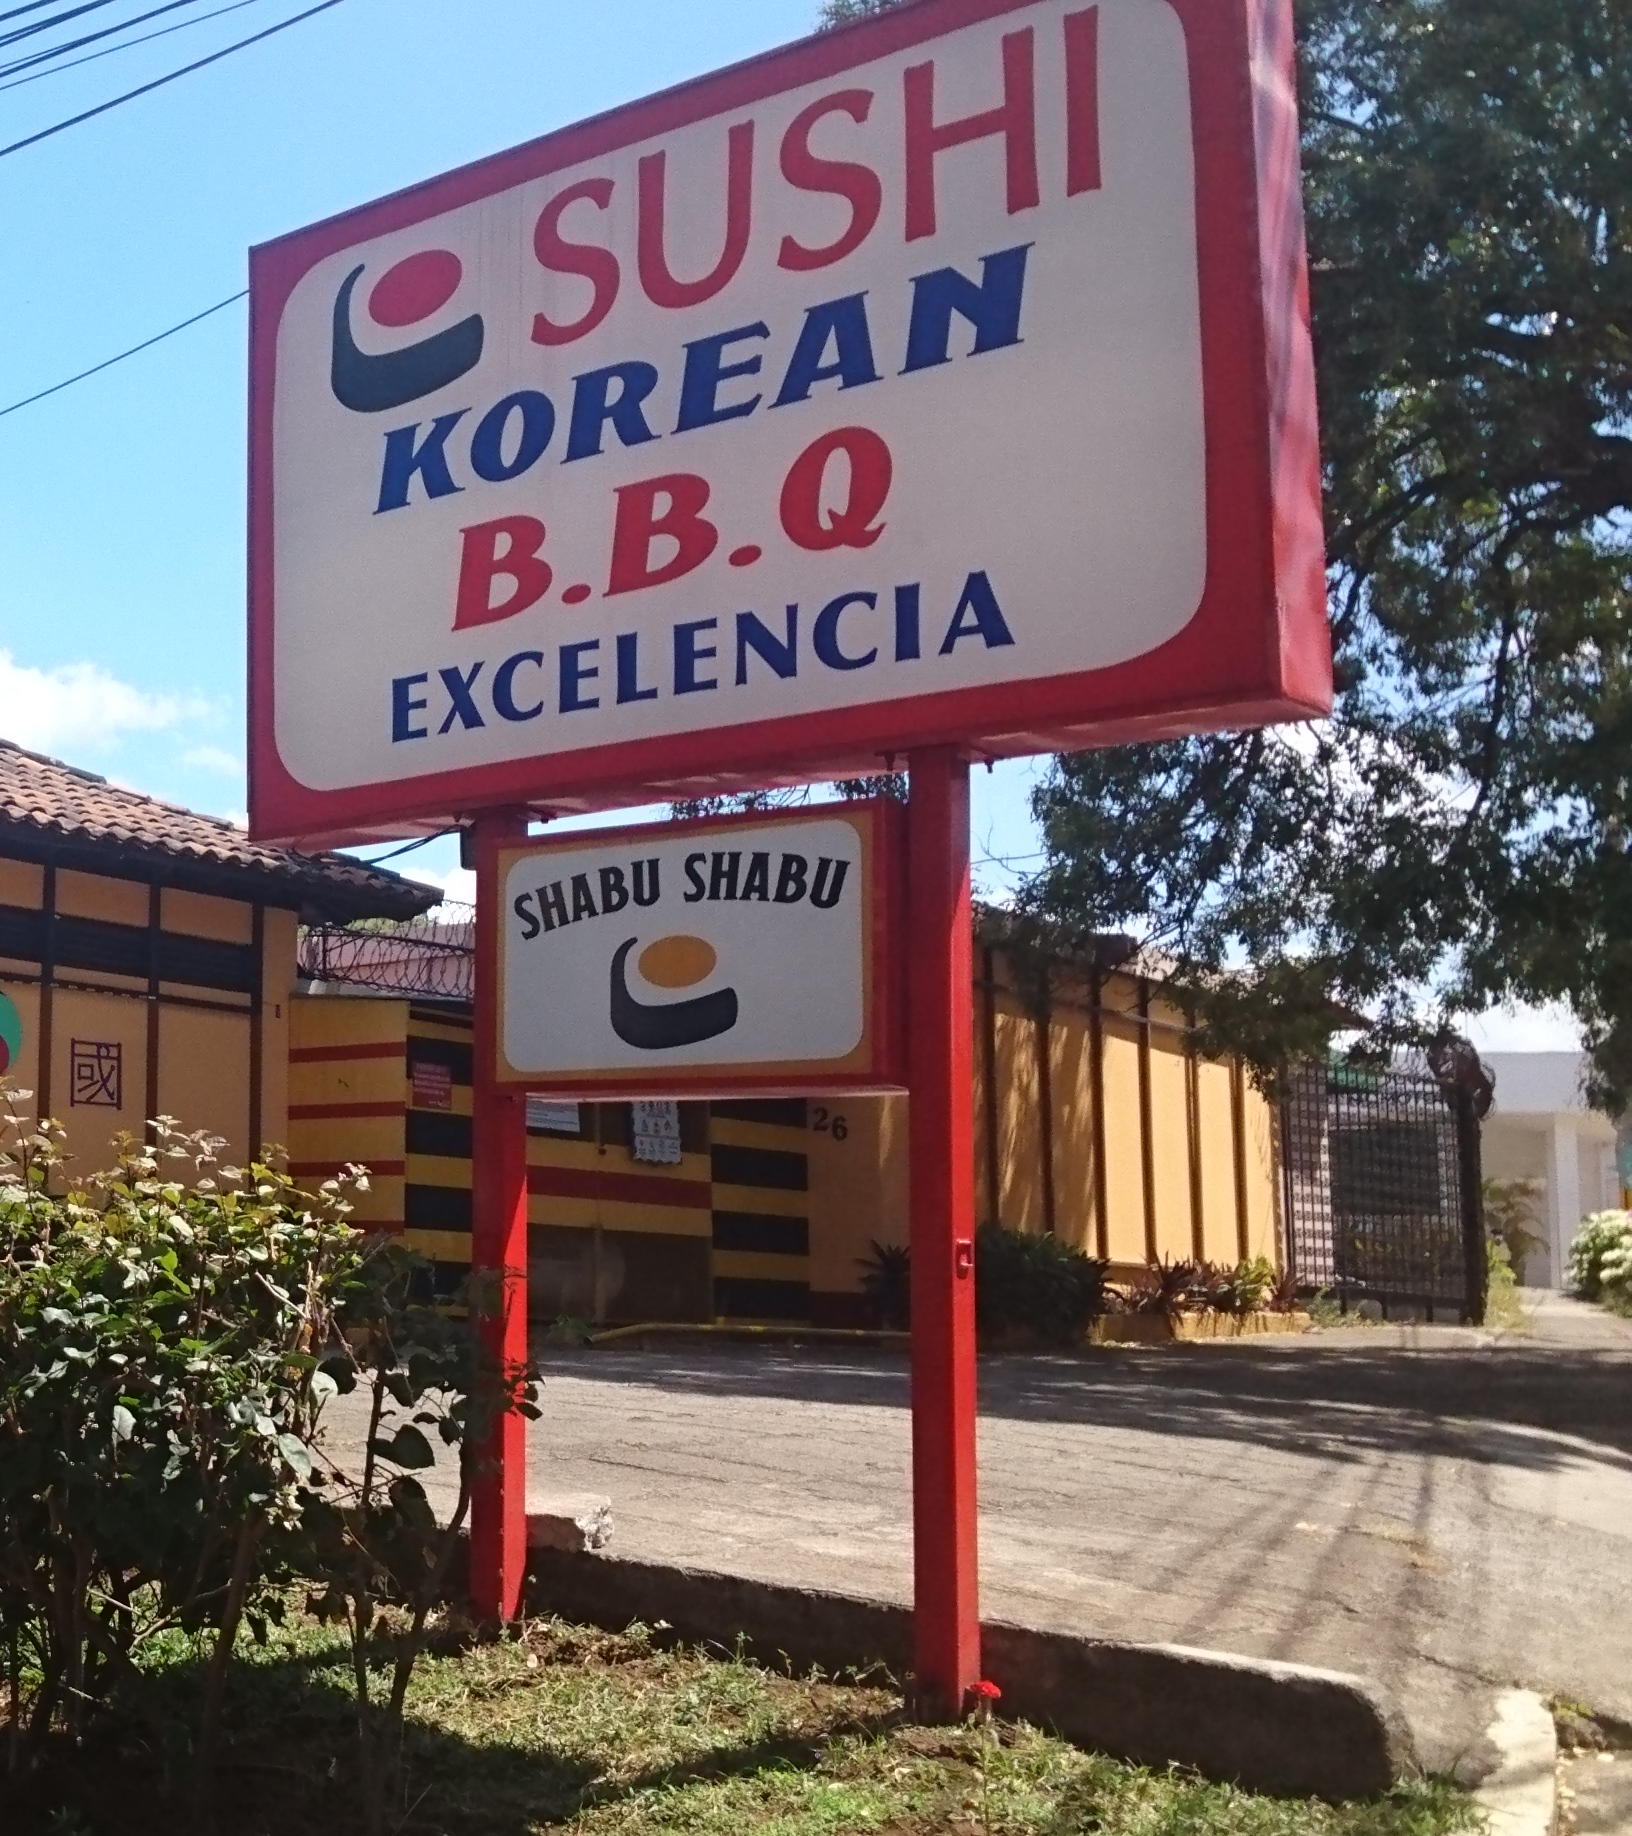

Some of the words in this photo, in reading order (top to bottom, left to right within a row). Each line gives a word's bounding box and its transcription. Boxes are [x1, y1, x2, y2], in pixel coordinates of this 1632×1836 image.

[531, 6, 1100, 346] SUSHI
[373, 243, 1035, 514] KOREAN
[451, 426, 893, 631] B.B.Q
[391, 571, 1015, 742] EXCELENCIA
[514, 858, 661, 940] SHABU
[683, 851, 851, 909] SHABU
[70, 1038, 122, 1110] 國
[813, 1107, 848, 1141] 26
